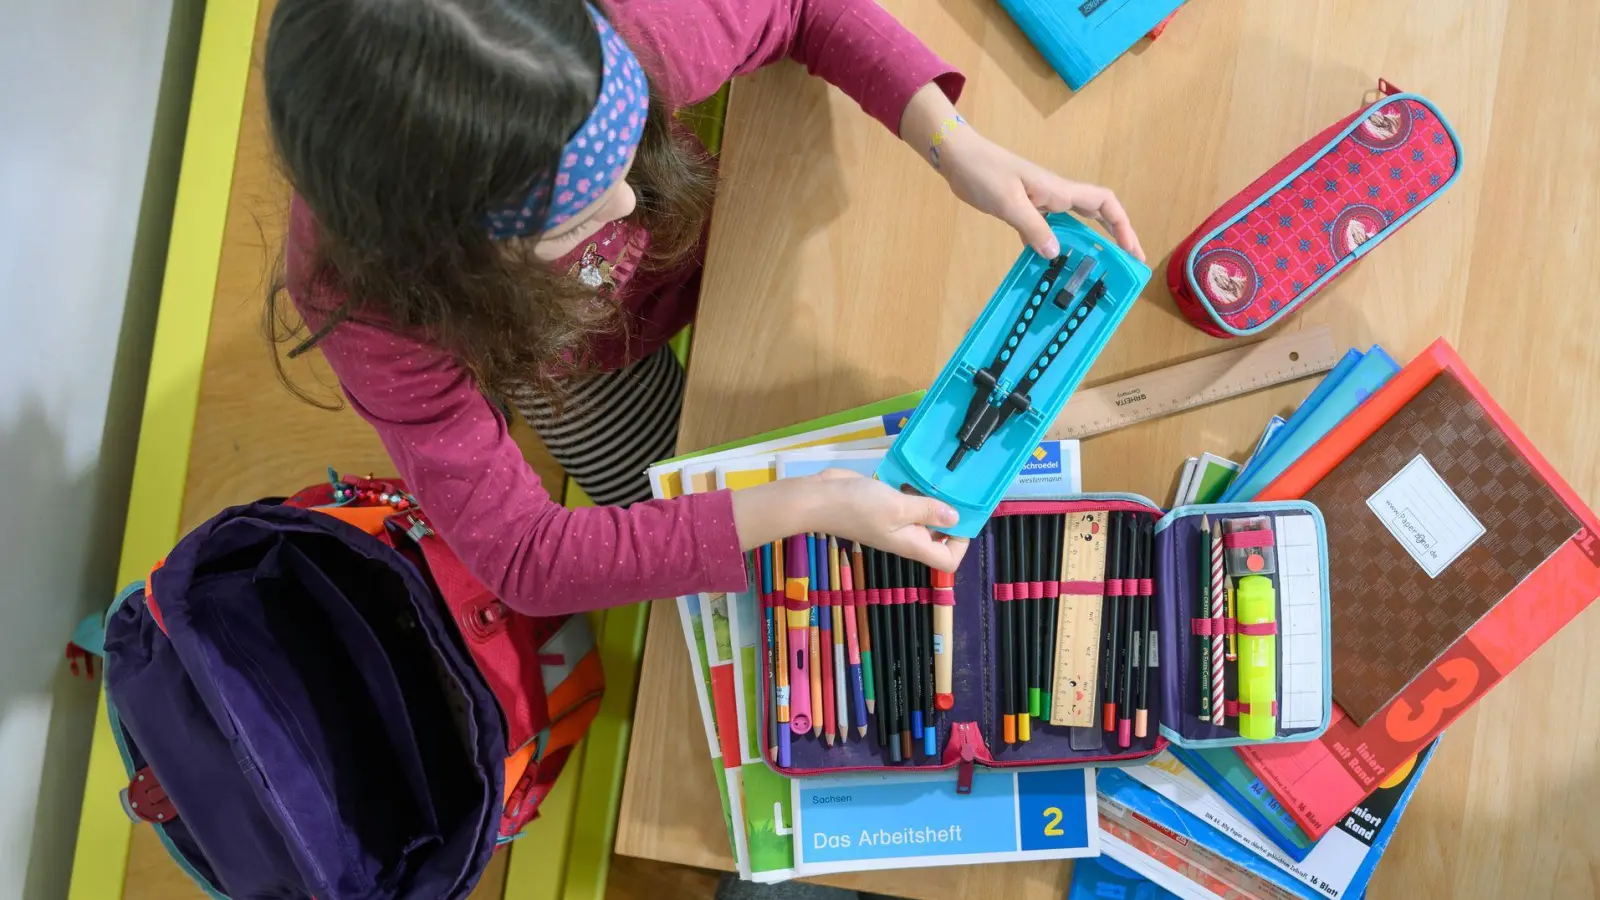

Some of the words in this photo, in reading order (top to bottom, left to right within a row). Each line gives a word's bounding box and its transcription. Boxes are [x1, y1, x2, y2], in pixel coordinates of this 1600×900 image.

[1019, 475, 1063, 484] westermann
[1386, 657, 1479, 742] 3
[1332, 741, 1352, 760] mit
[1347, 757, 1376, 786] Rand
[1355, 742, 1386, 776] liniert
[812, 795, 852, 805] Sachsen
[1043, 806, 1065, 836] 2
[1305, 811, 1323, 830] Blatt
[1344, 816, 1375, 841] Rand
[813, 832, 851, 849] Das
[858, 825, 962, 846] Arbeitsheft
[1230, 827, 1243, 839] Papier
[1309, 875, 1318, 885] 16
[1319, 882, 1339, 898] Blatt
